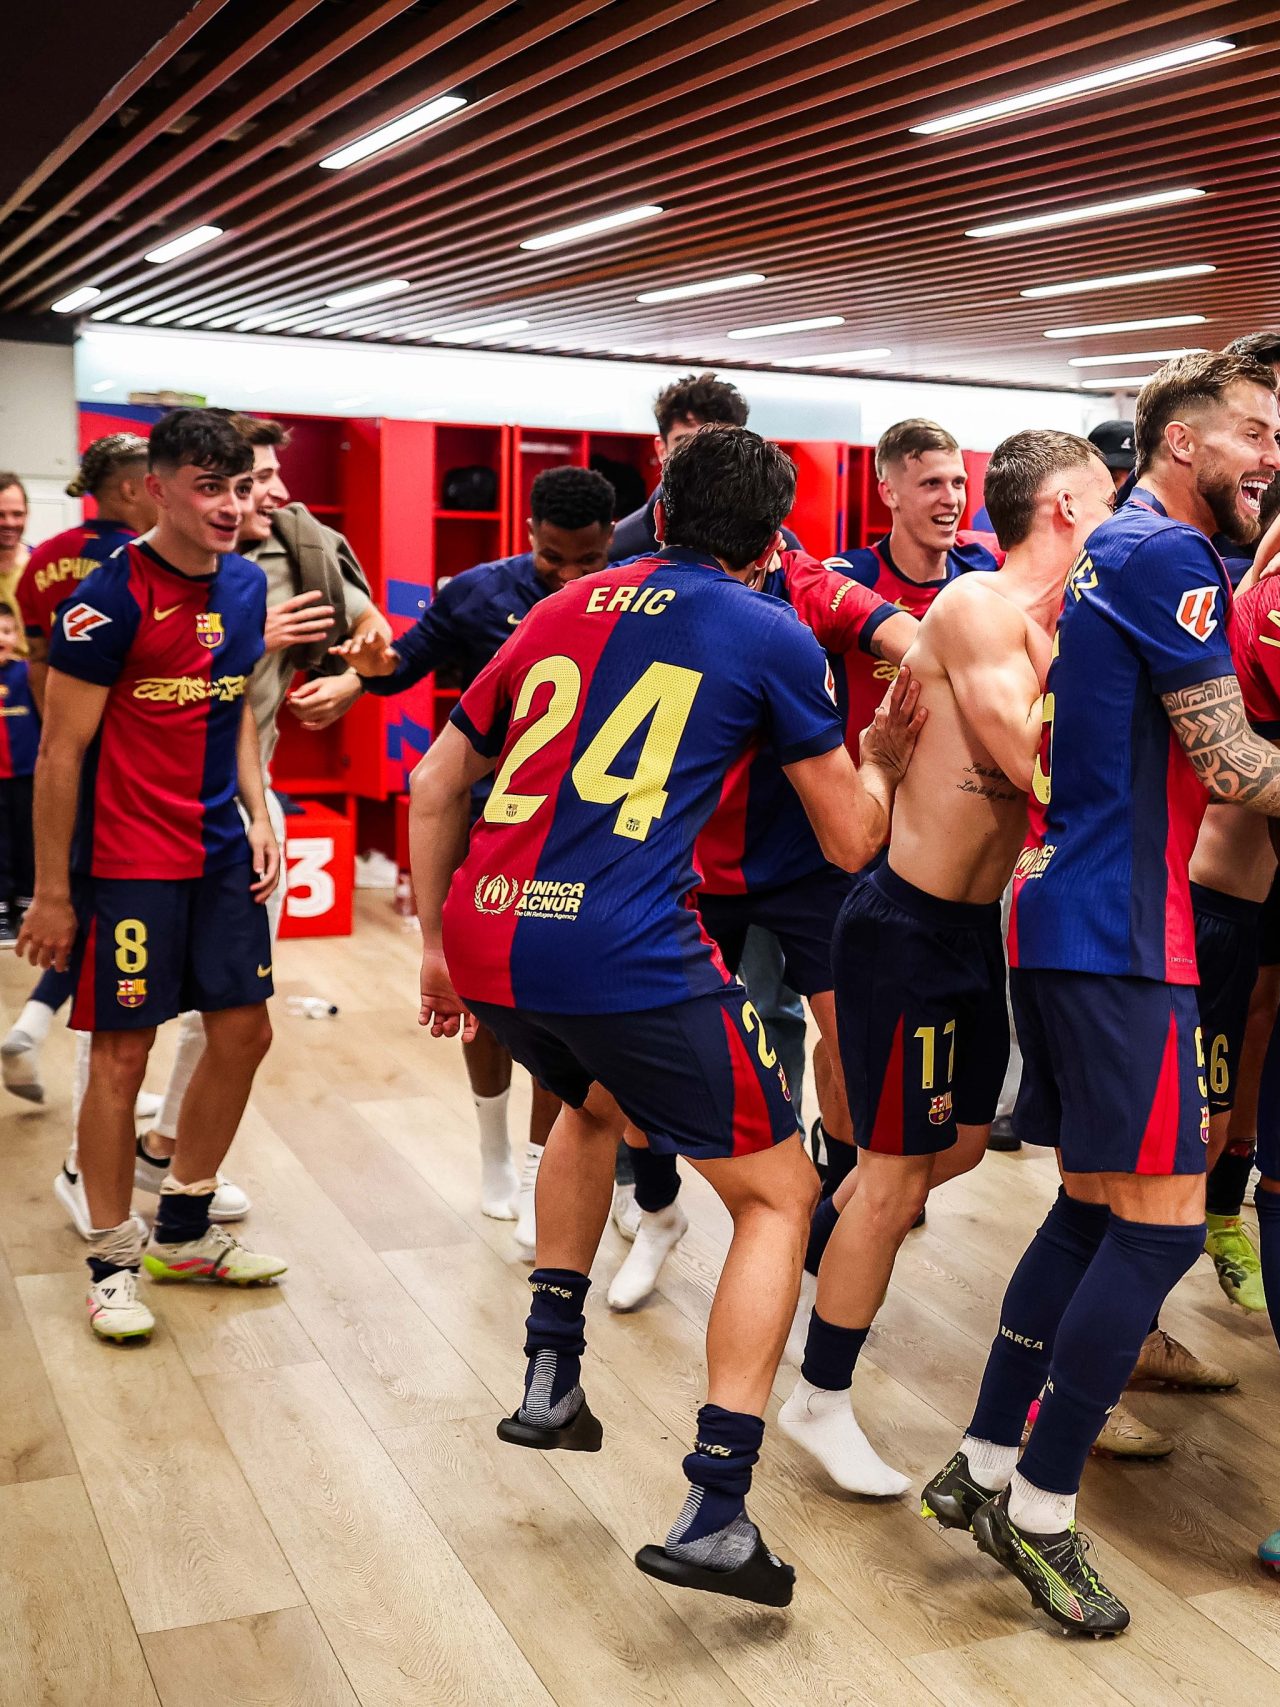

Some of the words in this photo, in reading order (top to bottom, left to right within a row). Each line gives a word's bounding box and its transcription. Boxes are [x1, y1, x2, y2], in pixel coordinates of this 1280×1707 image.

[585, 586, 676, 616] ERIC
[483, 655, 703, 841] 24
[515, 895, 581, 913] ACNUR
[522, 880, 585, 898] UNHCR
[523, 910, 533, 918] UN
[533, 911, 554, 920] Refugee
[554, 912, 577, 921] Agency
[114, 918, 147, 974] 8
[1209, 1033, 1230, 1094] 6
